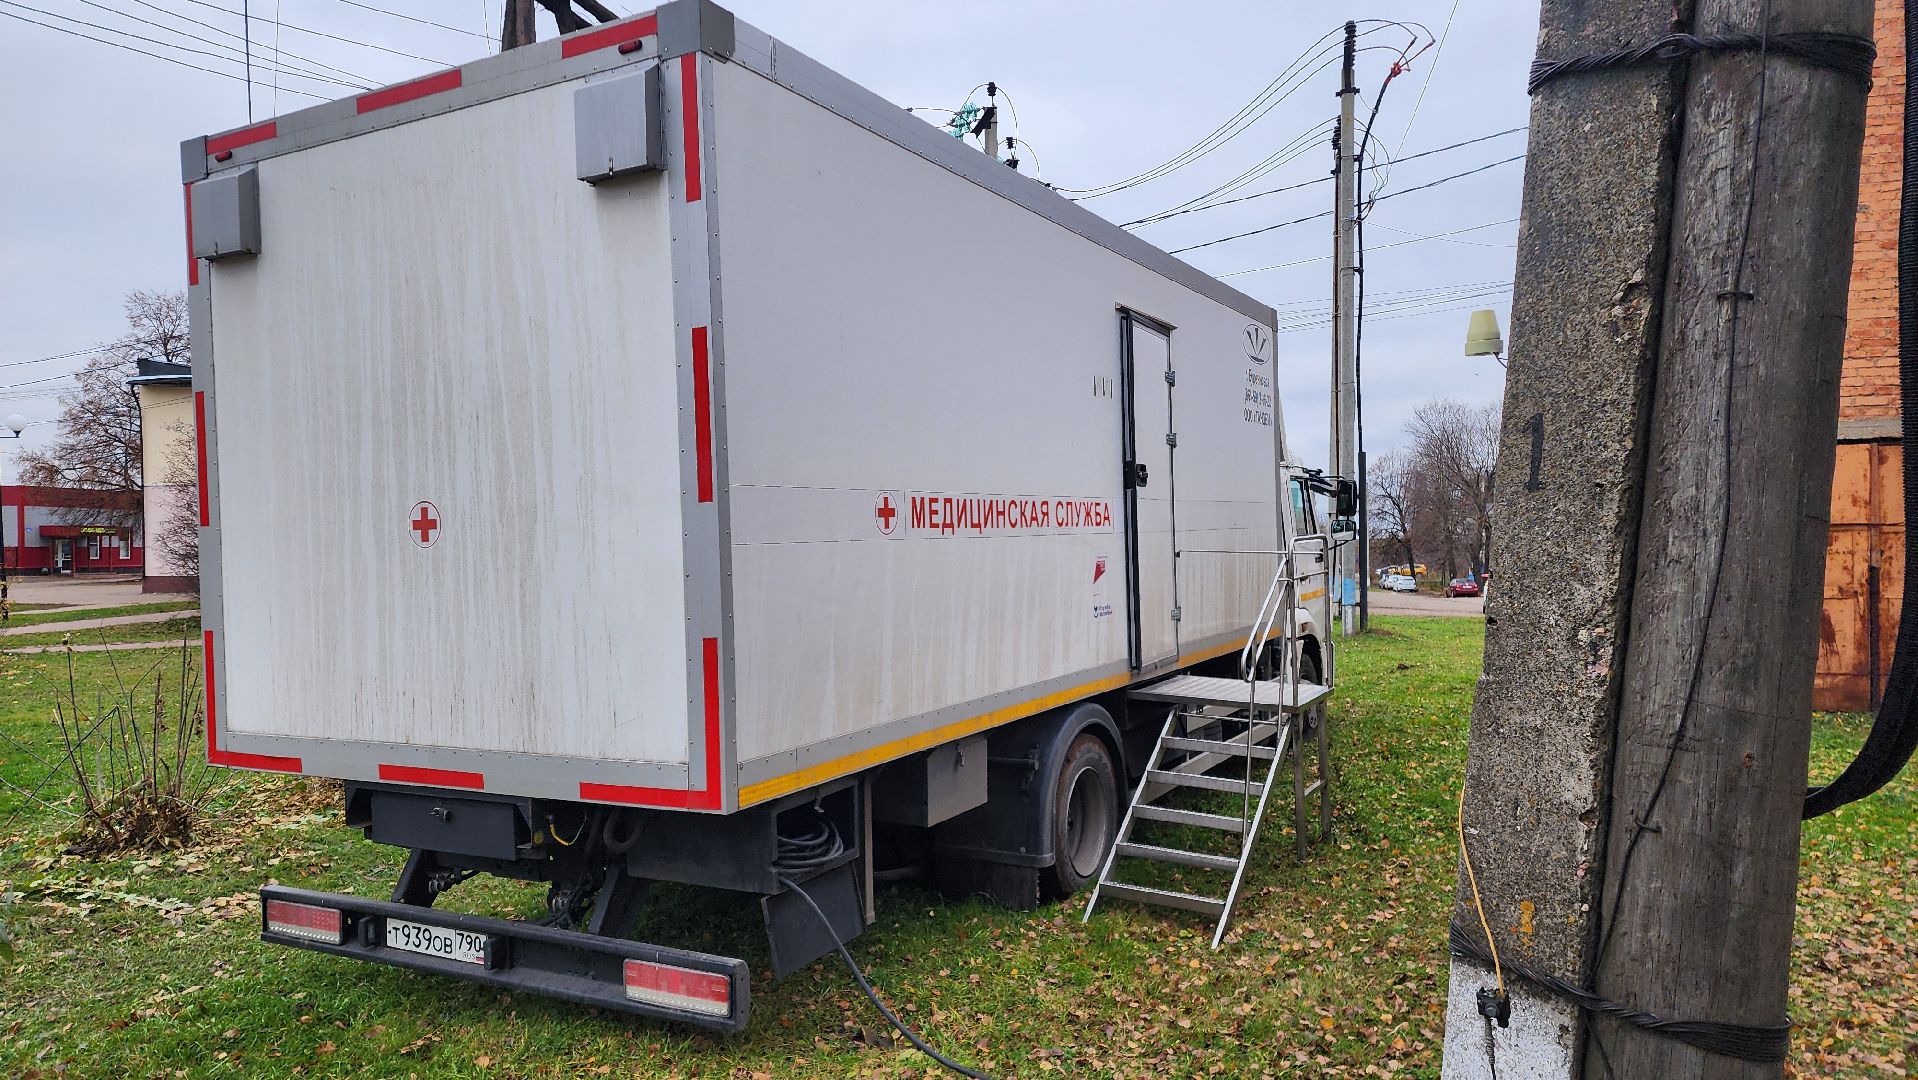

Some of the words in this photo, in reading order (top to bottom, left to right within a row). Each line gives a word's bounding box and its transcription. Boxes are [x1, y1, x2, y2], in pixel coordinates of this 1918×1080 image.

[911, 496, 1049, 535] МЕДИЦИНСКАЯ
[1055, 500, 1111, 528] СЛУЖБА
[392, 924, 453, 954] Т939ОВ
[456, 932, 482, 952] 790
